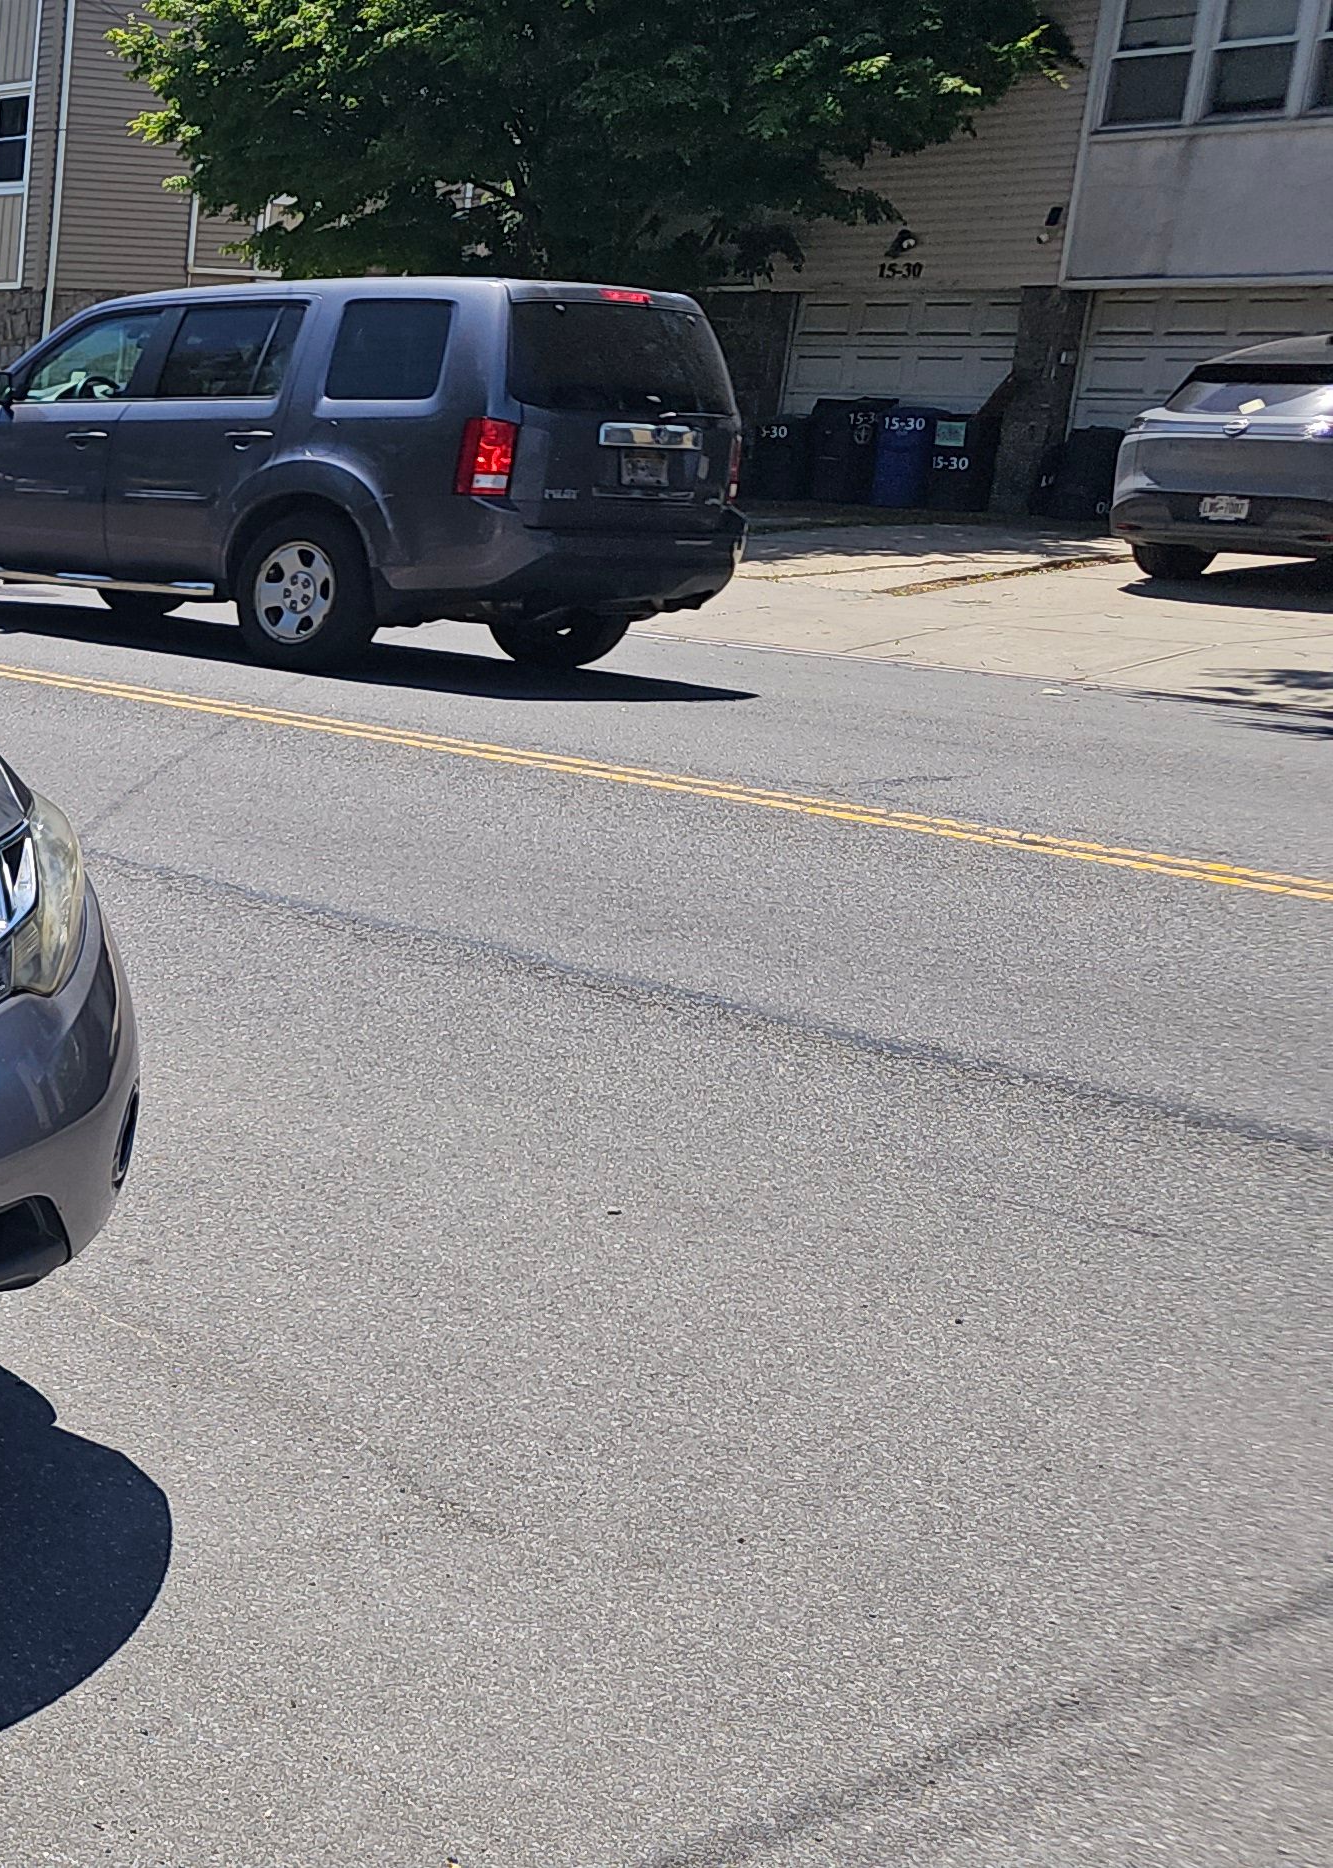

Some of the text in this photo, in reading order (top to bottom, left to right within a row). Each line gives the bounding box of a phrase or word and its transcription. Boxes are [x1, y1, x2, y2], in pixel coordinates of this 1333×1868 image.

[879, 262, 924, 279] 15-30
[849, 411, 879, 425] 15-3
[884, 416, 926, 431] 15-30
